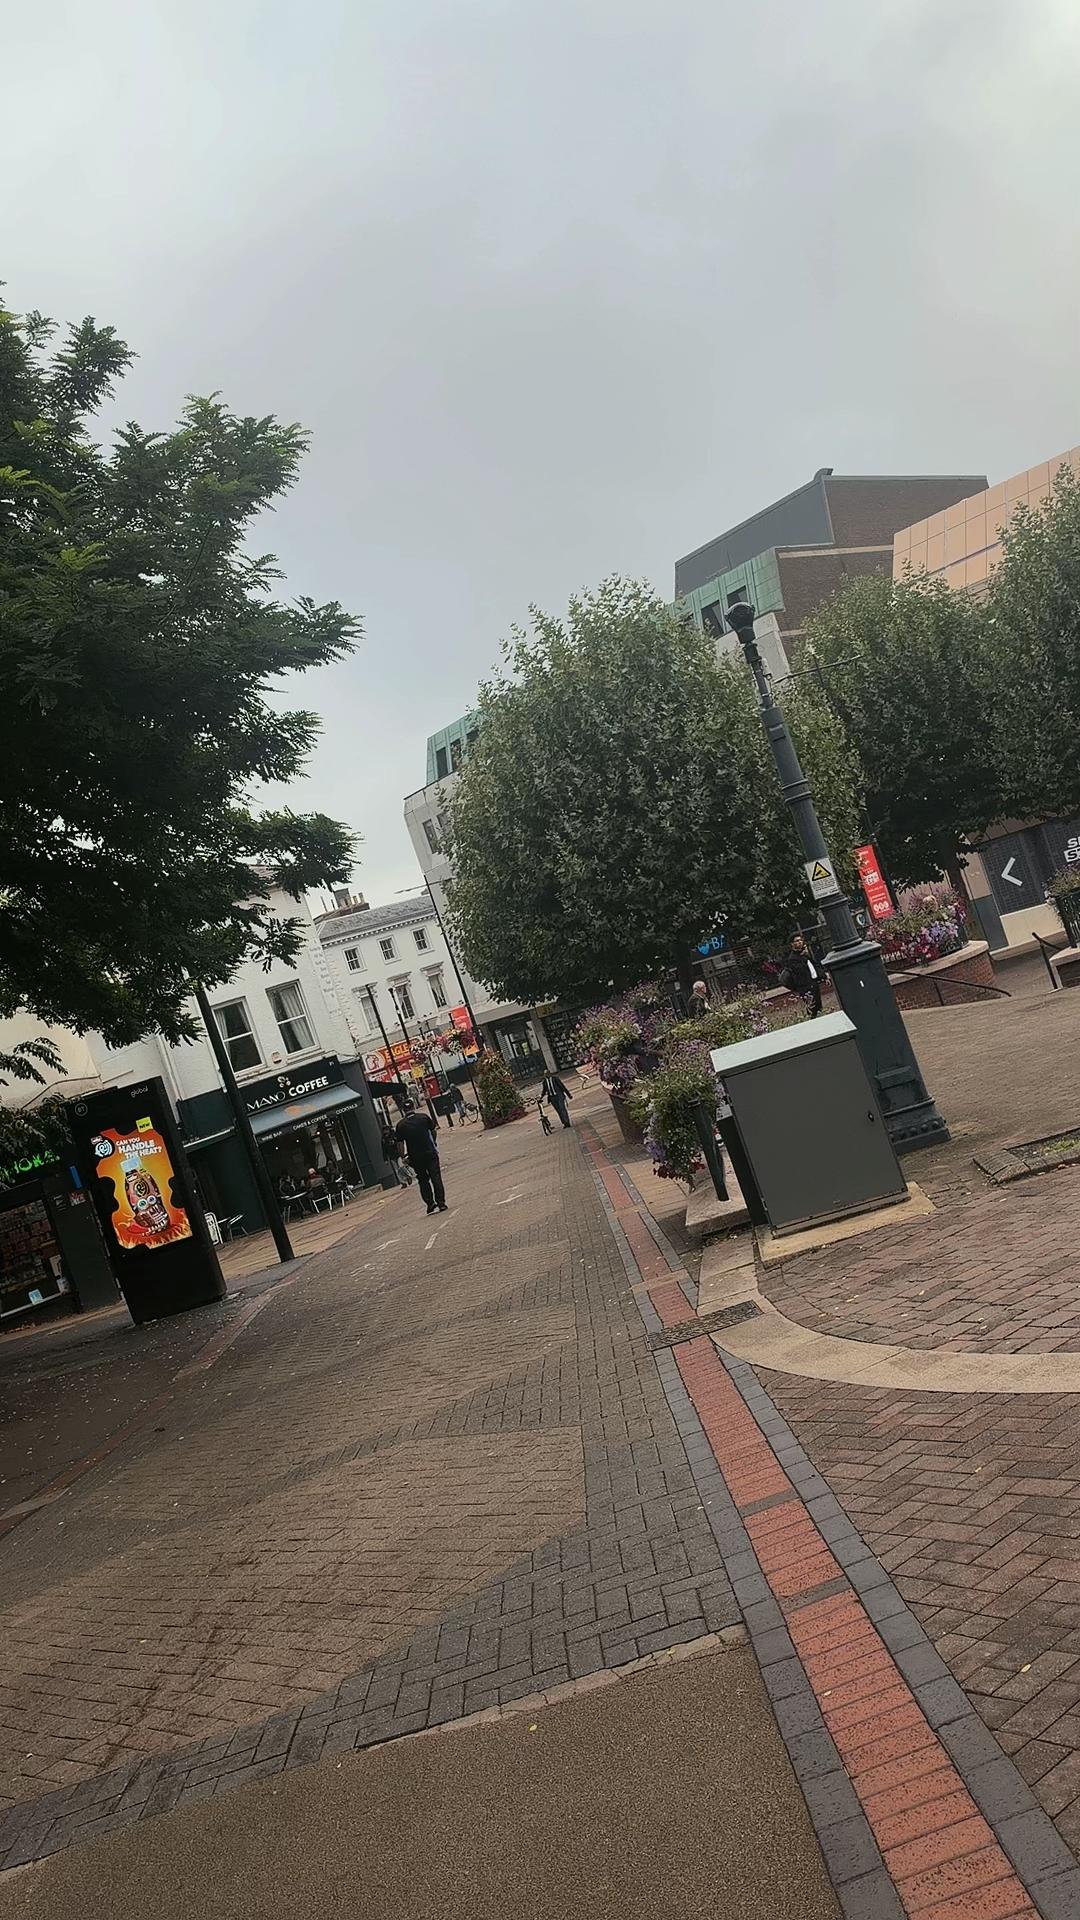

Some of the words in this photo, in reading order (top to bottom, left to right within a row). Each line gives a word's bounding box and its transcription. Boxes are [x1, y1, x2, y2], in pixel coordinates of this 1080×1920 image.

[130, 1085, 149, 1098] global
[246, 1090, 286, 1111] MANO
[288, 1075, 329, 1097] COFFEE
[118, 1139, 155, 1154] HANDLE
[124, 1150, 139, 1160] THE
[139, 1146, 163, 1157] HEAT?
